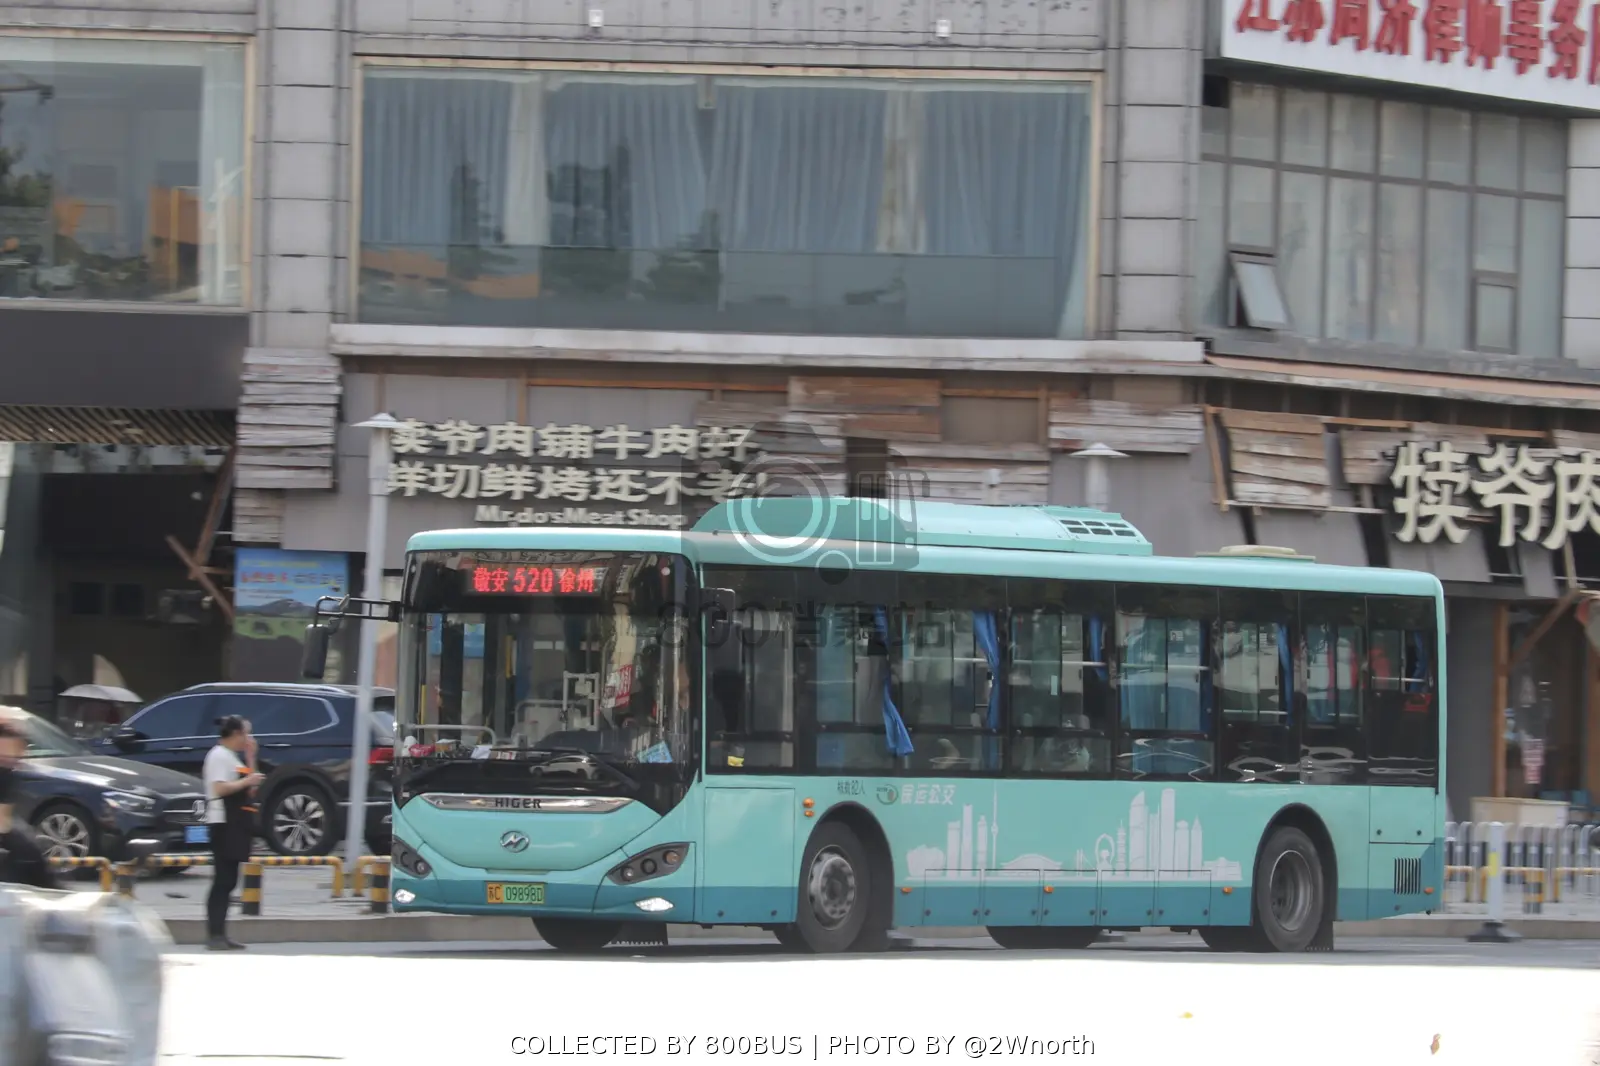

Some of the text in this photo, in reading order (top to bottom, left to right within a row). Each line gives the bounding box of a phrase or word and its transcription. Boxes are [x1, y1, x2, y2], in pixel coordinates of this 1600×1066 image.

[1236, 0, 1600, 85] 苏同济律师事务
[513, 567, 554, 592] 520
[559, 567, 595, 593] 徐州
[495, 798, 542, 809] HIGER
